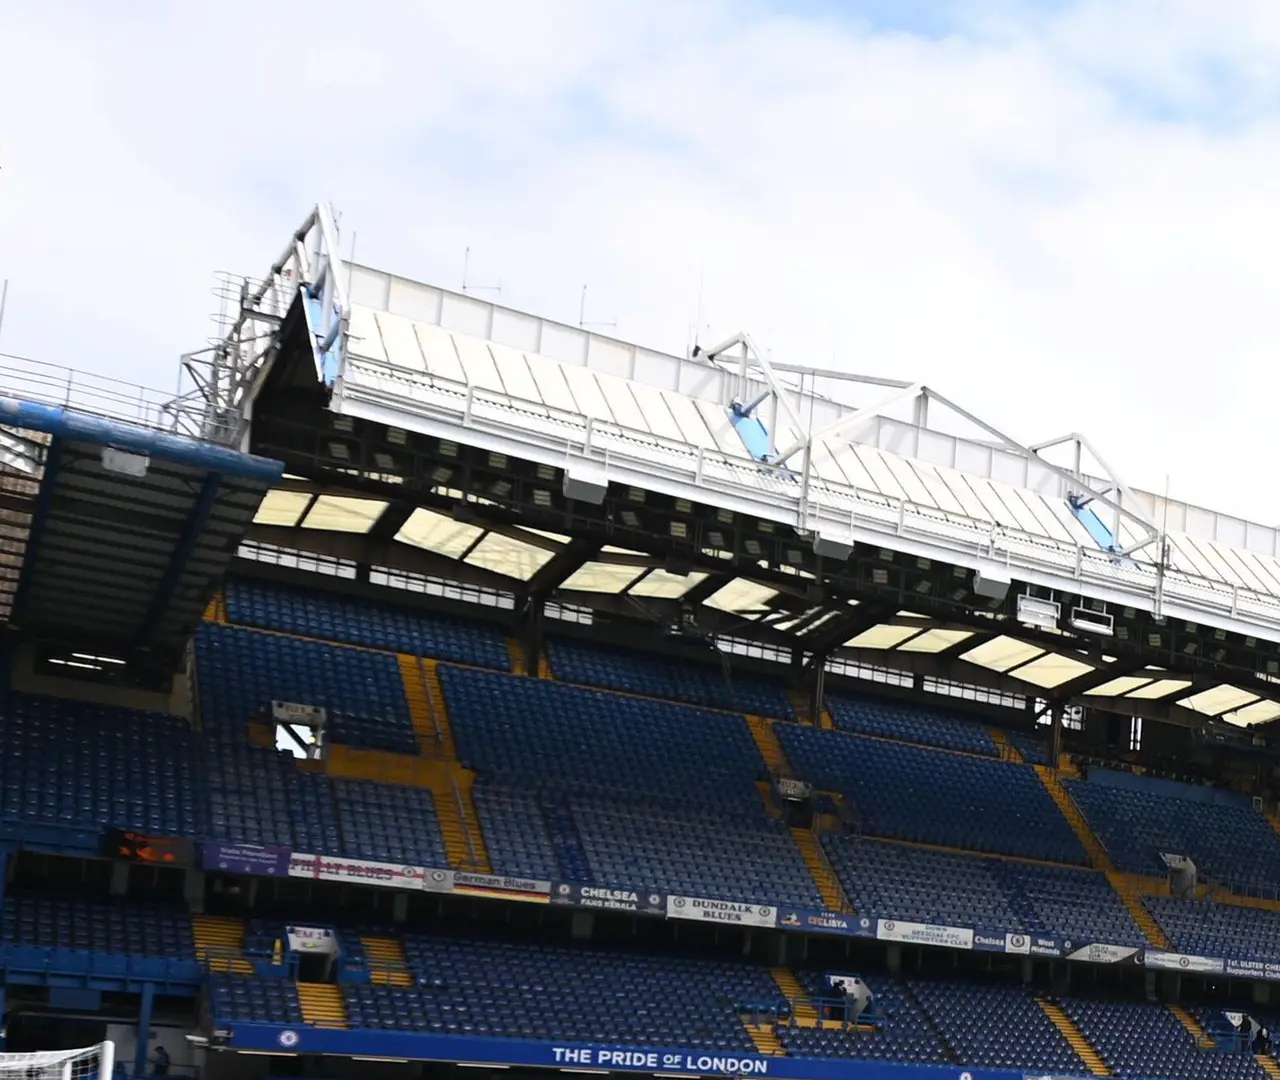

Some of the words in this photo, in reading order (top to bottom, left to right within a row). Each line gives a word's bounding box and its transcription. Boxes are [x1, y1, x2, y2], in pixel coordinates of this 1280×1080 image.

[453, 872, 500, 886] German
[503, 878, 536, 890] Blues
[580, 887, 638, 902] CHELSEA
[604, 900, 637, 911] KERALA
[692, 900, 753, 914] DUNDALK
[703, 910, 742, 921] BLUES
[1037, 939, 1055, 947] West
[1031, 945, 1060, 956] Midlands
[1240, 960, 1264, 970] ULSTER
[1226, 967, 1264, 979] Supporters
[552, 1047, 592, 1064] THE
[597, 1049, 658, 1067] PRIDE
[663, 1054, 682, 1068] OF
[686, 1056, 768, 1073] LONDON
